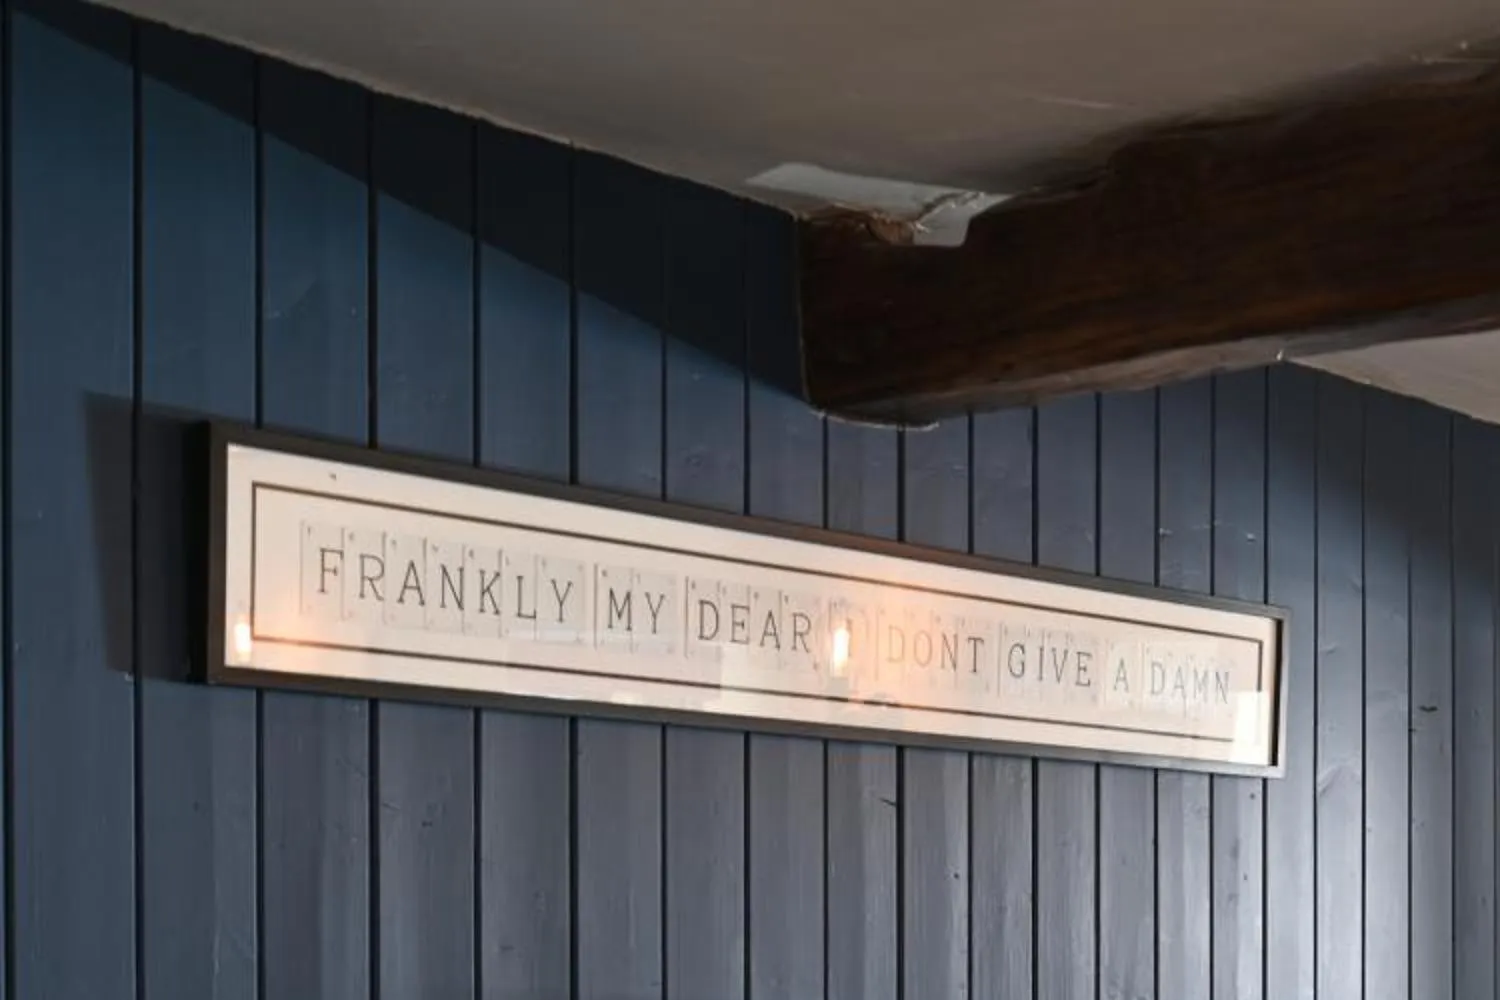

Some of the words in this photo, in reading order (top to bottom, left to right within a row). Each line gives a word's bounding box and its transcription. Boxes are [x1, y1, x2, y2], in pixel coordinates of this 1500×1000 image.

[317, 547, 573, 623] FRANKLY
[607, 587, 665, 635] MY
[698, 599, 813, 653] DEAR
[886, 625, 985, 674] DONT
[1007, 642, 1093, 688] GIVE
[1113, 658, 1130, 693] A
[1149, 661, 1231, 705] DAMN
